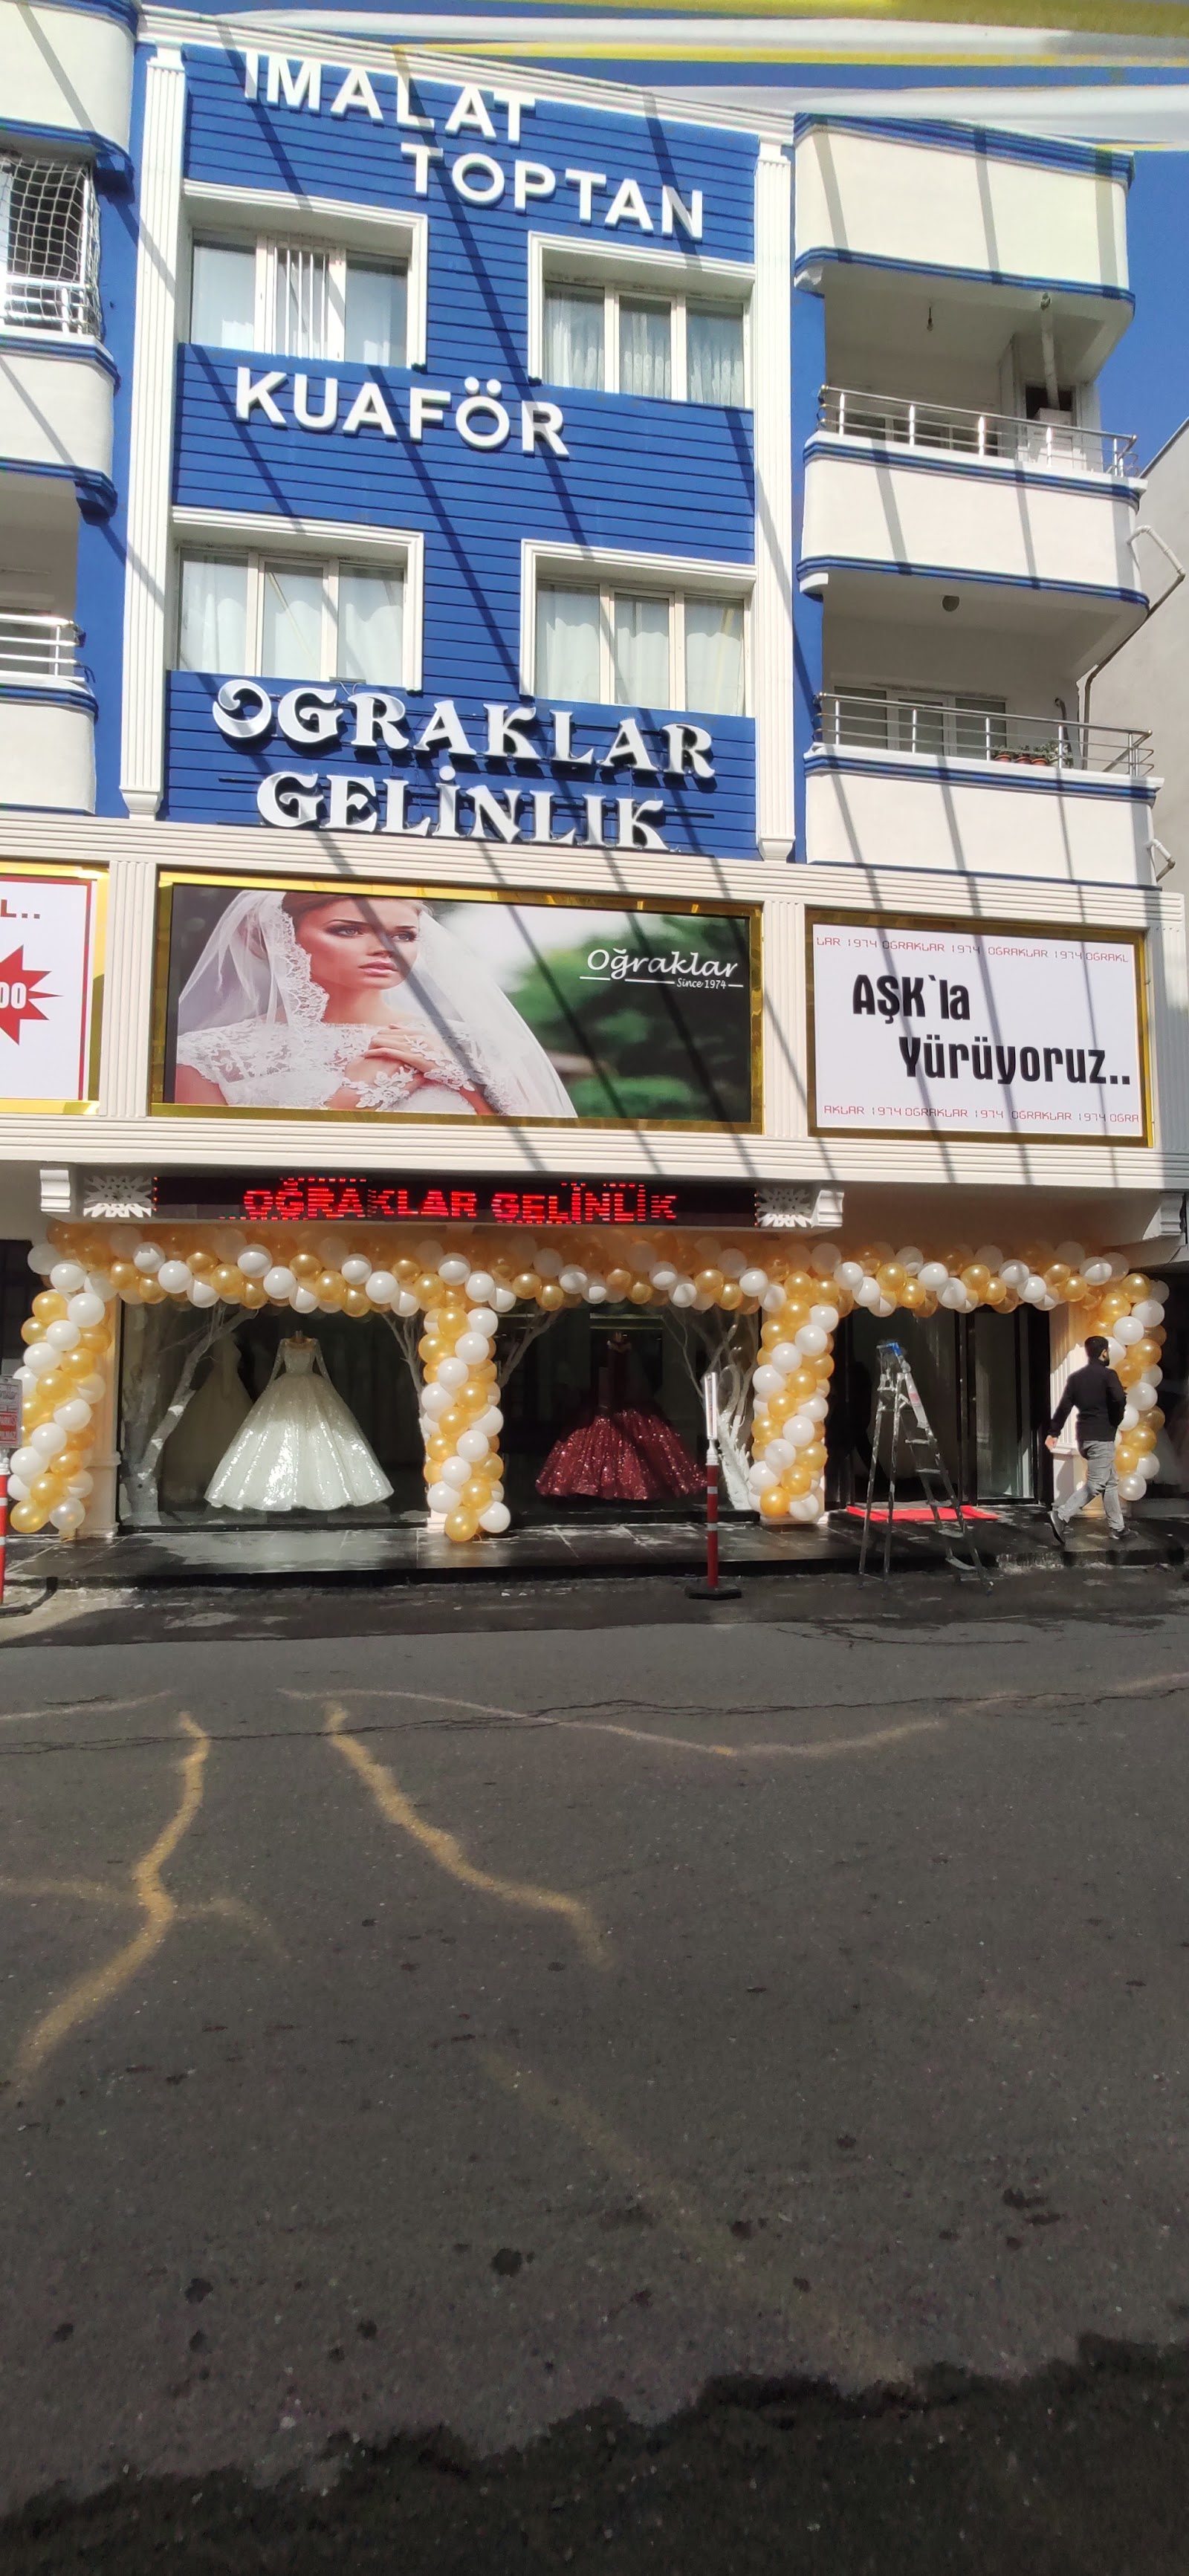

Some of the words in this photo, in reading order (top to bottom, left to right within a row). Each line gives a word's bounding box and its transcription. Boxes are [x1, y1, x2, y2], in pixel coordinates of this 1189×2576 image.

[244, 49, 535, 145] IMALAT
[401, 143, 702, 241] TOPTAN
[236, 367, 569, 458] KUAFÖR
[587, 948, 738, 979] Oğraklar
[816, 937, 840, 947] LAR
[848, 938, 878, 948] 1974
[952, 944, 981, 954] 1974
[1054, 950, 1083, 960] 1974
[676, 978, 703, 989] Since
[704, 979, 727, 990] 1974
[898, 1034, 1130, 1085] Yürüyoruz..
[823, 1105, 864, 1115] AKLAR
[872, 1106, 902, 1116] 1974
[975, 1109, 1003, 1119] 1974
[1078, 1112, 1106, 1122] 1974
[1109, 1113, 1139, 1123] OGRA
